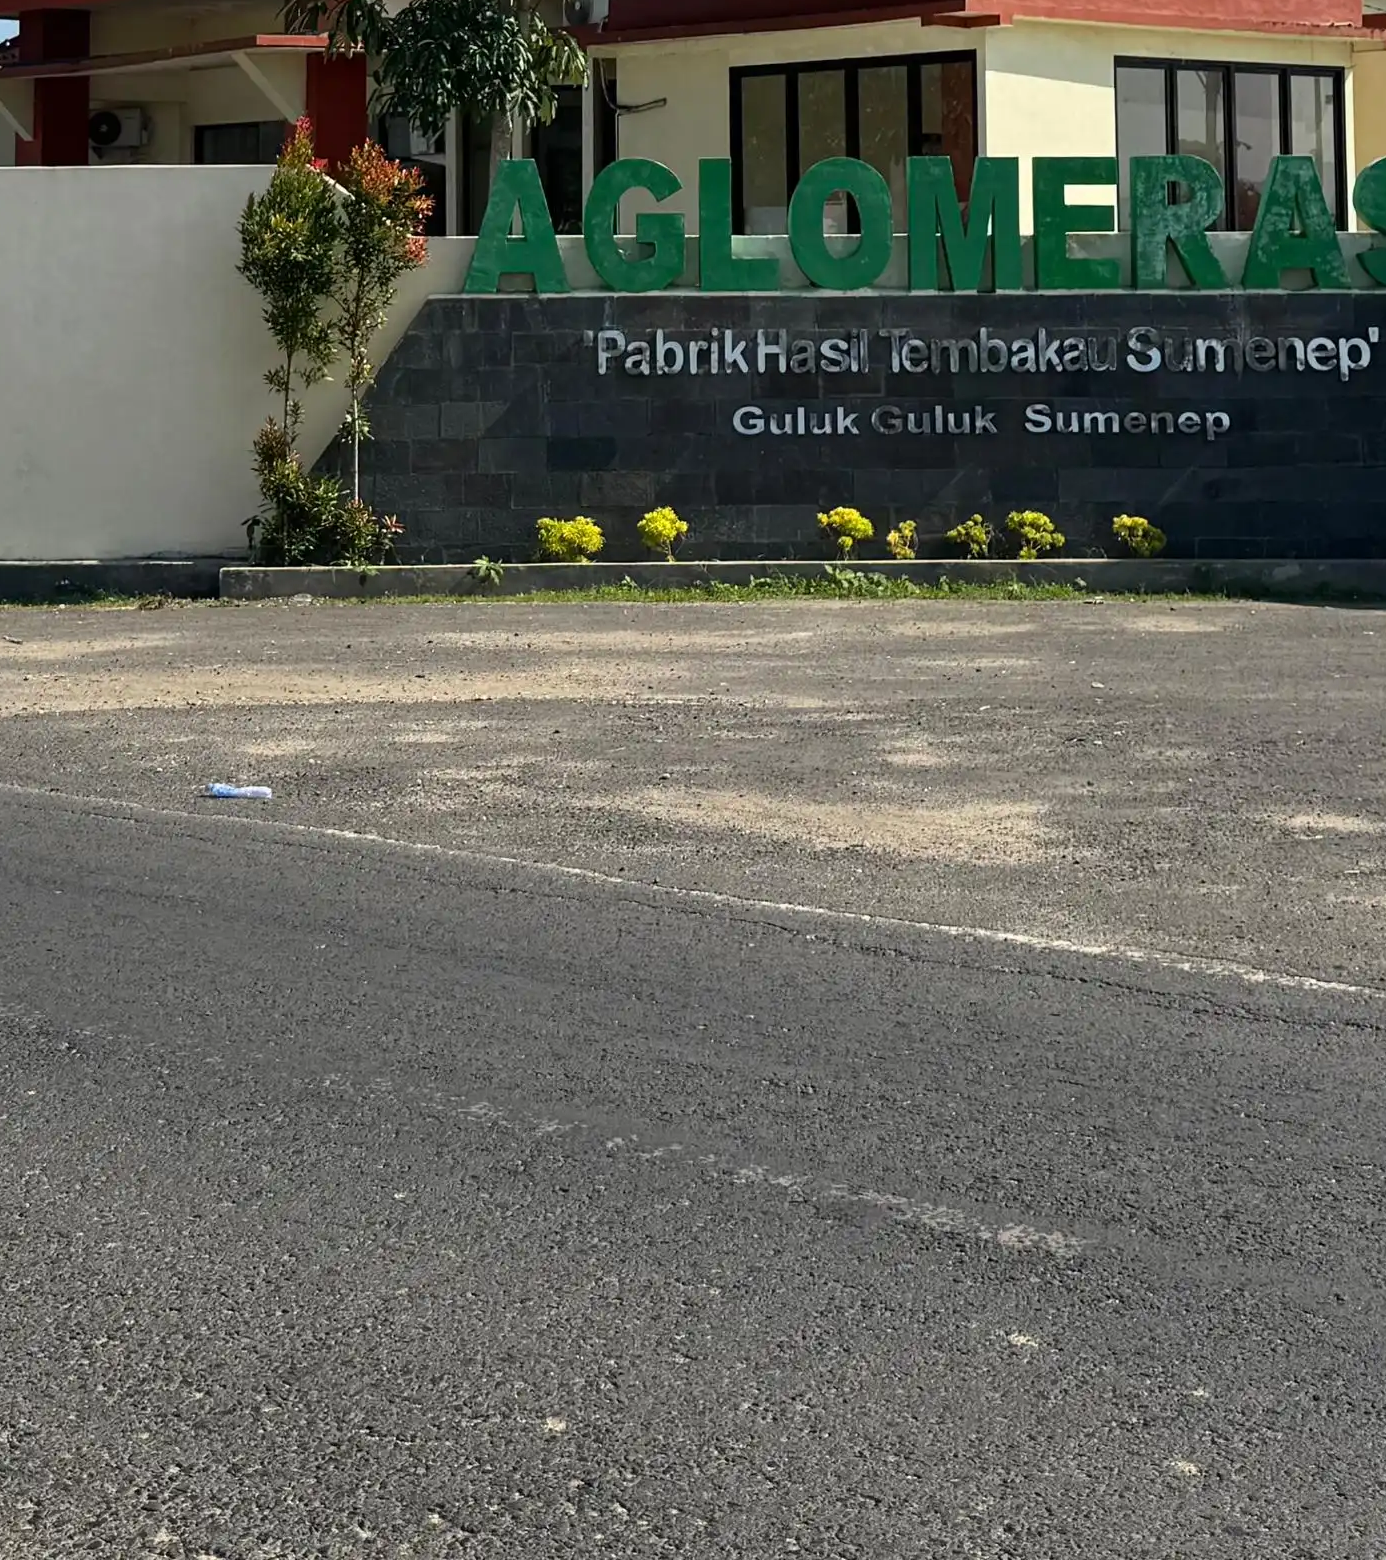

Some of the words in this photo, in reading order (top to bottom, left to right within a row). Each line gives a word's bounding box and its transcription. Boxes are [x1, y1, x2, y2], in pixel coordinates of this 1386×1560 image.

[879, 326, 1117, 375] Tembakau
[732, 406, 860, 436] Guluk
[871, 404, 998, 435] Guluk
[1024, 403, 1231, 441] Sumenep
